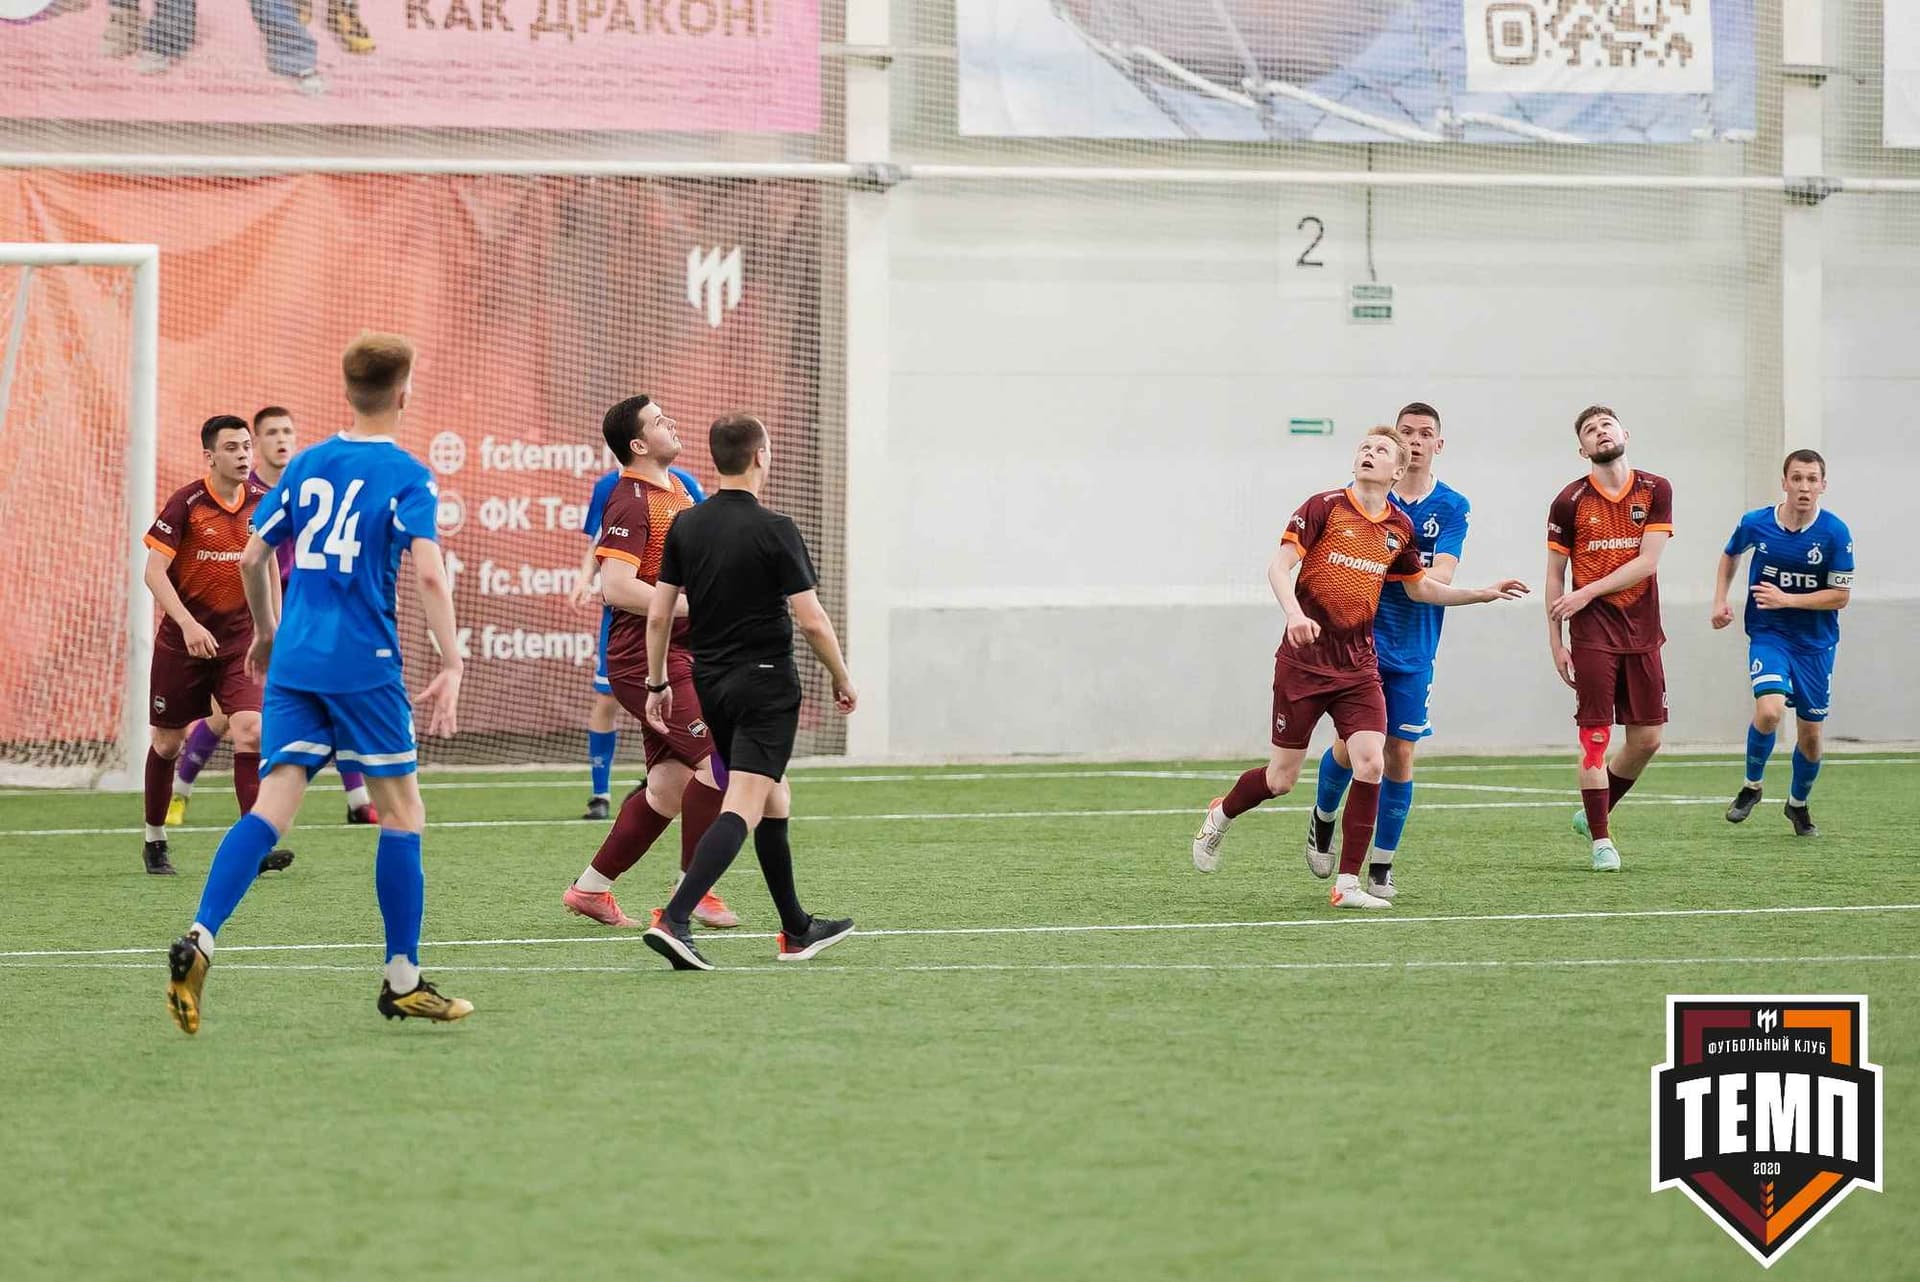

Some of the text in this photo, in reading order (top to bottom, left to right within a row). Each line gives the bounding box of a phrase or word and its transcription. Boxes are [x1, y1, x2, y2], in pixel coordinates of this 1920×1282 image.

[405, 0, 514, 32] КАК
[1297, 216, 1324, 267] 2
[296, 478, 364, 573] 24
[480, 496, 531, 531] ФК
[1780, 571, 1819, 589] ВТБ
